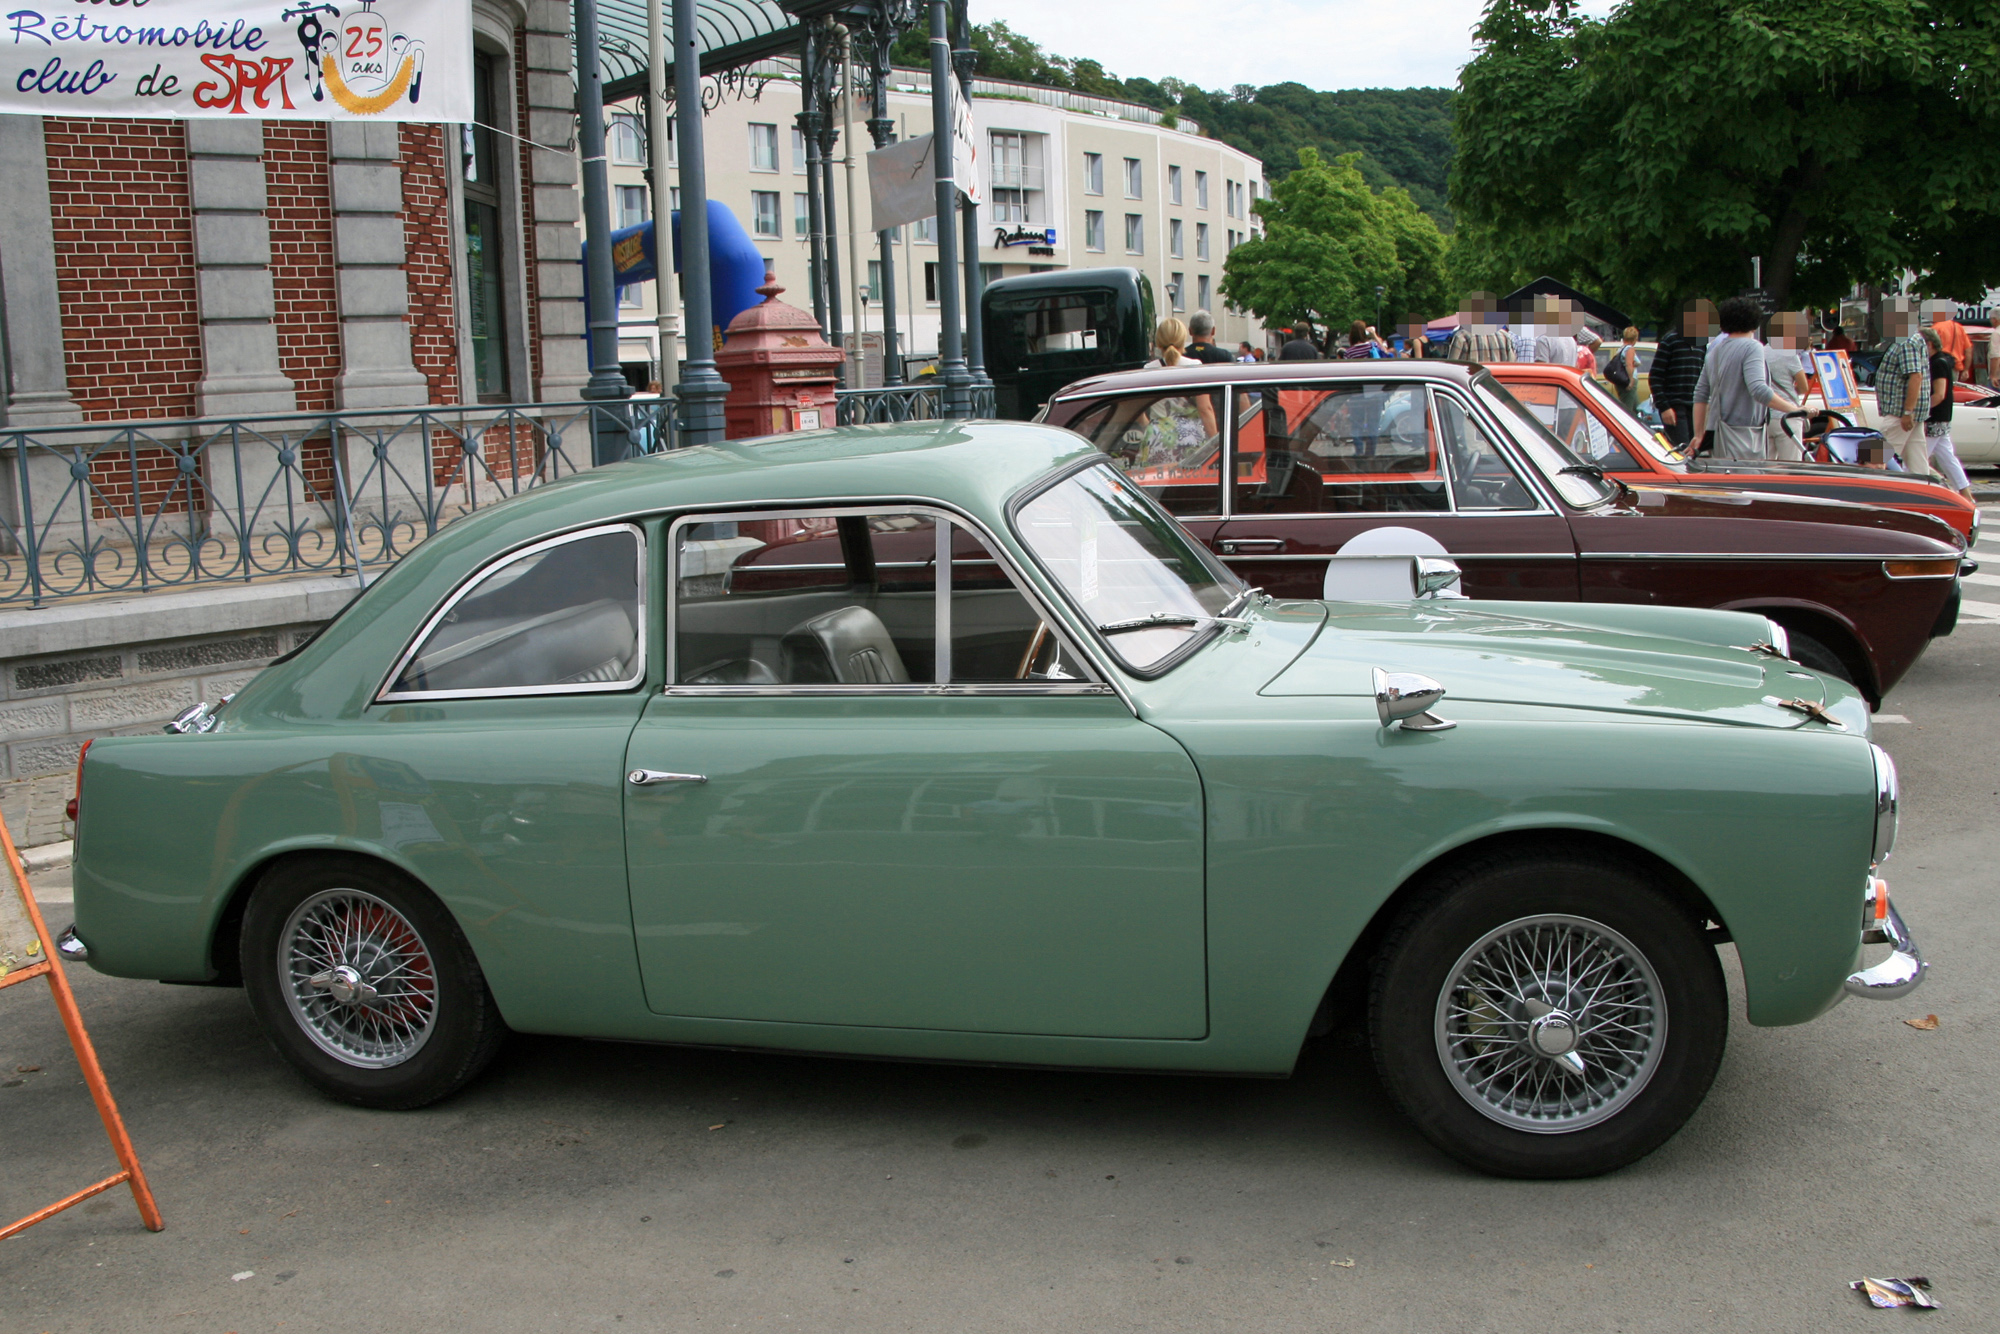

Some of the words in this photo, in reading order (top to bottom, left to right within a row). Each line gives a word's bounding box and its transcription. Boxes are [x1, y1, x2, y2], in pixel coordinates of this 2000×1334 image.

[6, 10, 270, 53] Rétromobile
[345, 25, 383, 59] 25
[16, 56, 118, 96] club
[135, 63, 183, 98] de
[192, 52, 297, 115] SPA
[994, 224, 1047, 250] Radisson
[1817, 355, 1837, 398] P
[1126, 431, 1141, 442] NL
